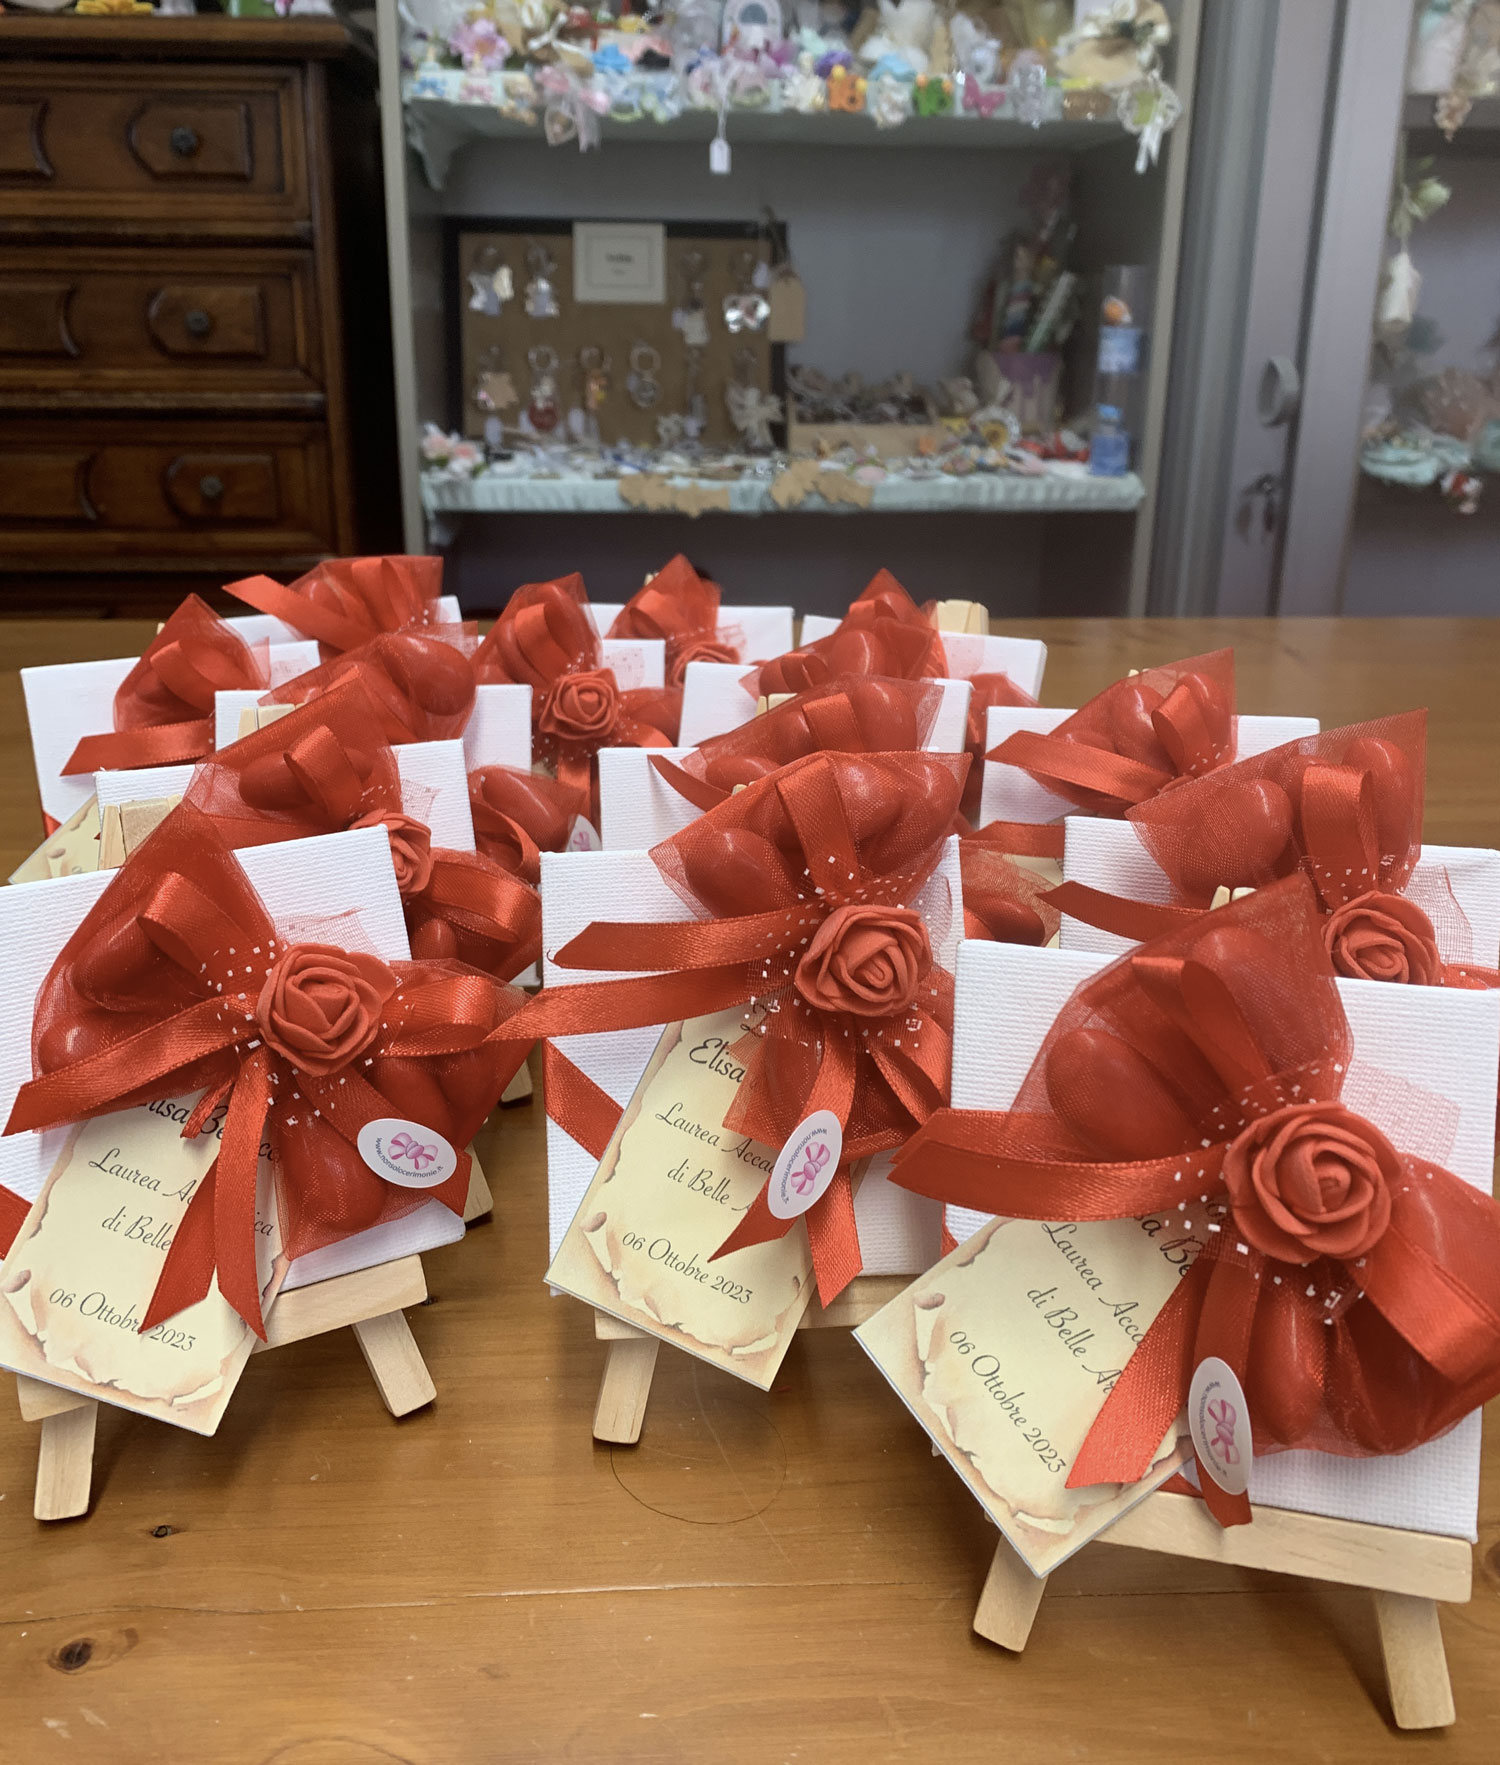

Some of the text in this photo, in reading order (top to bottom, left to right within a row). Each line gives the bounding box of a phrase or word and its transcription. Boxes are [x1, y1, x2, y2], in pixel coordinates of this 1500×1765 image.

[689, 1037, 746, 1083] Elisa
[655, 1102, 720, 1147] Laurea
[88, 1148, 161, 1191] Laurea
[667, 1158, 731, 1205] di Belle
[101, 1206, 173, 1251] di Belle
[622, 1231, 753, 1304] 06 Ottobre 2023
[1041, 1223, 1104, 1291] Laurea
[49, 1288, 196, 1351] 06 Ottobr 2023
[1027, 1287, 1058, 1309] di
[1043, 1307, 1096, 1358] Belle
[949, 1331, 1067, 1474] 06 Ottobre 2023
